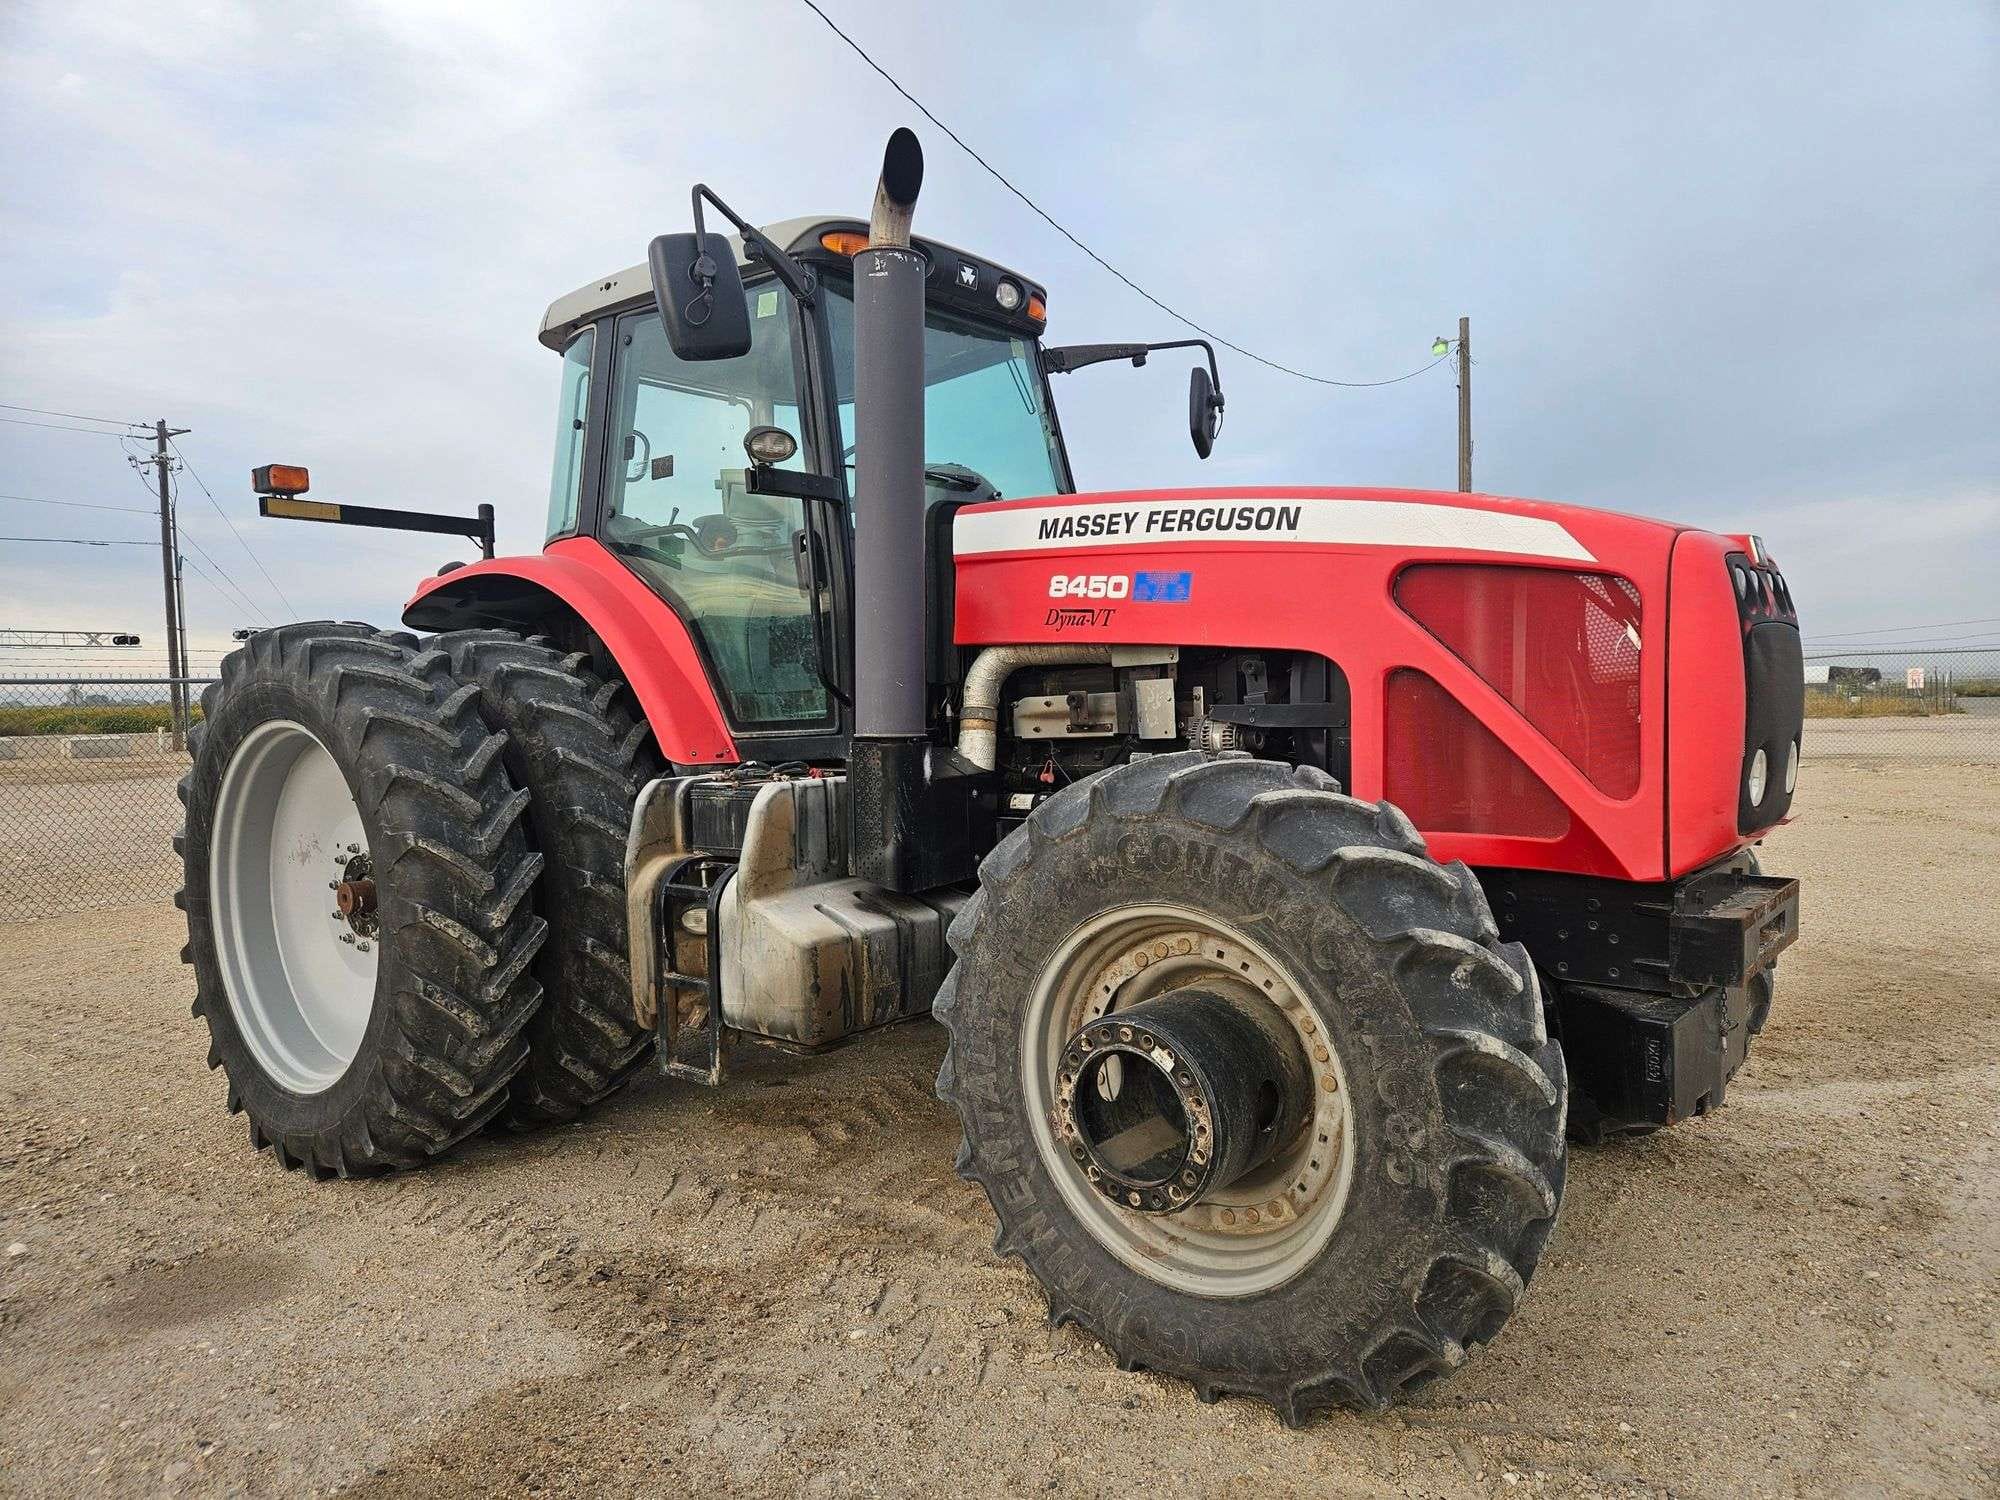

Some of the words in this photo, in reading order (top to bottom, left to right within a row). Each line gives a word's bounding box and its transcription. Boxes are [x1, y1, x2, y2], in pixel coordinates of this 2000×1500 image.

[1038, 511, 1139, 540] MASSEY
[1145, 506, 1302, 534] FERGUSON
[1048, 575, 1129, 599] 8450
[1045, 607, 1116, 632] Dyna-VT
